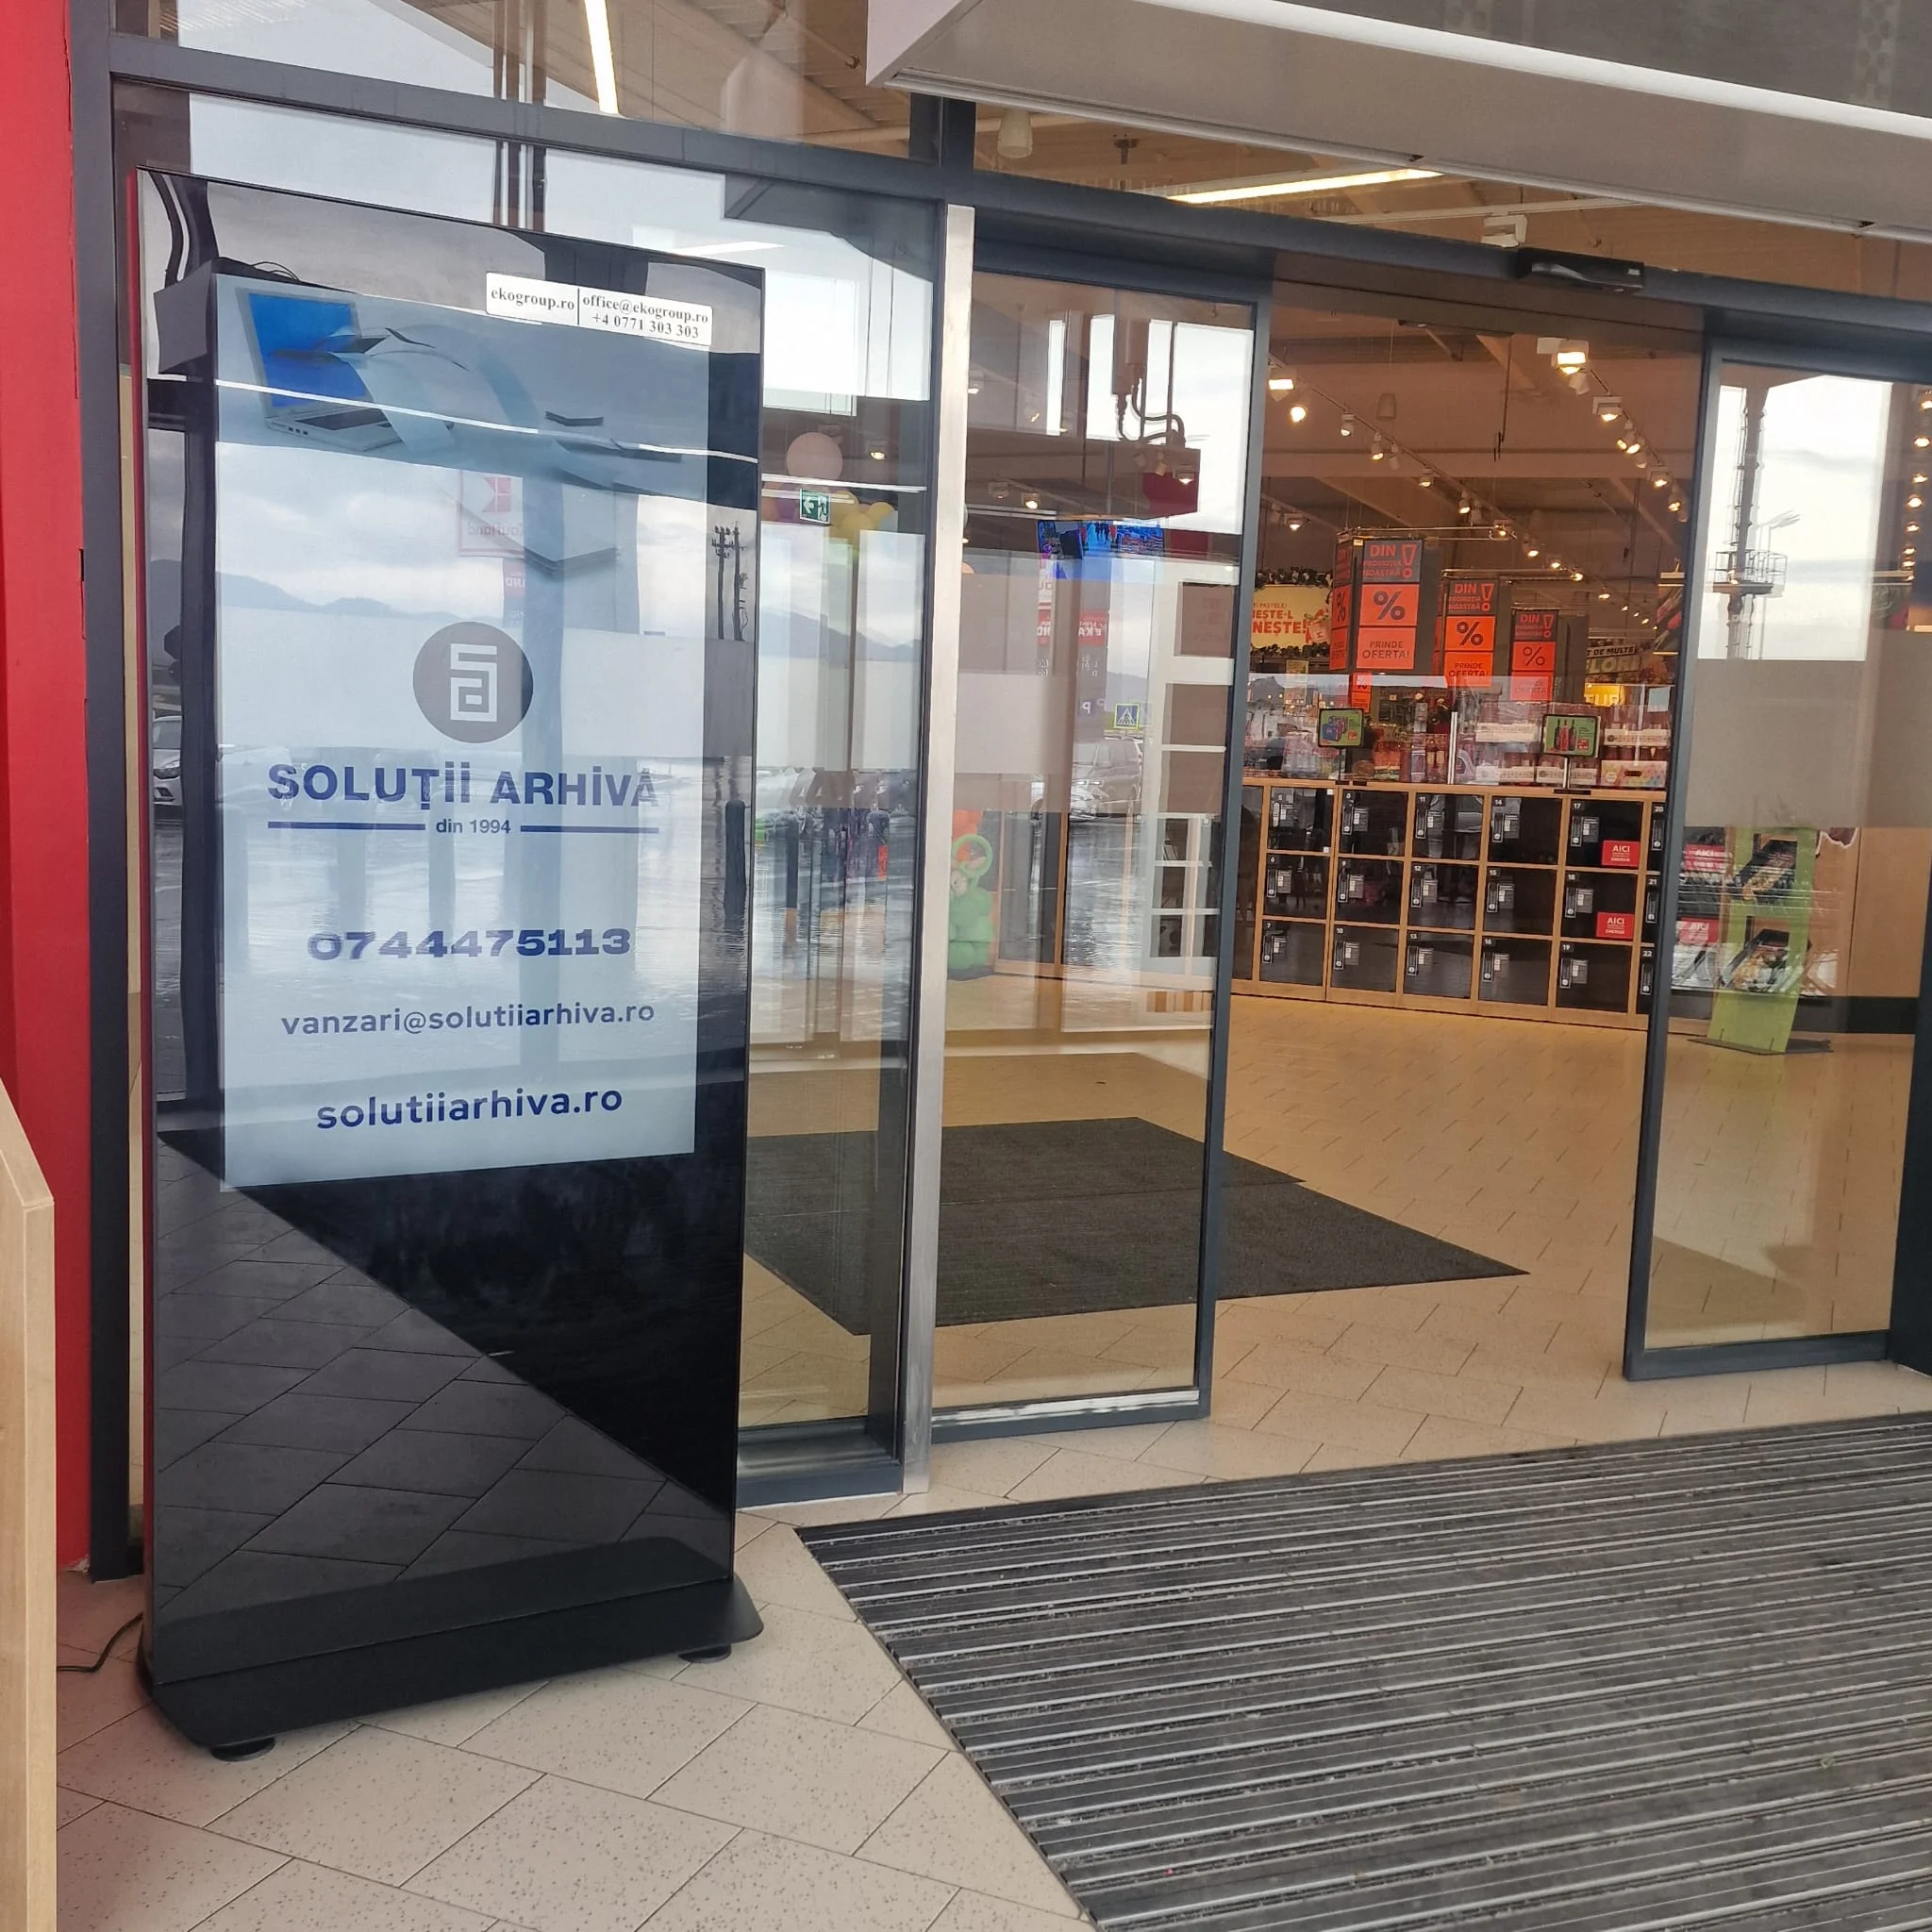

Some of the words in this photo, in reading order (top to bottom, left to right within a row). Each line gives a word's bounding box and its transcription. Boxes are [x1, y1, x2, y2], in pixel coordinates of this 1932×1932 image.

[491, 287, 575, 310] ekogroup.ro
[582, 294, 708, 324] office@ekogroup.ro
[592, 314, 609, 325] +4
[613, 314, 644, 331] 0771
[648, 320, 673, 335] 303
[675, 325, 699, 340] 303
[1370, 544, 1395, 557] DIN
[1455, 584, 1477, 594] DIN
[1373, 591, 1406, 620] %
[1520, 614, 1540, 623] DIN
[1456, 621, 1484, 646] %
[1362, 649, 1410, 659] OFERTA!
[1369, 641, 1404, 649] PRINDE
[1523, 646, 1546, 666] %
[435, 819, 463, 834] din
[470, 819, 511, 834] 1994
[1612, 844, 1630, 853] AICI
[308, 927, 631, 960] 0744475113
[281, 1002, 656, 1035] vanzari@solutiiarhiva.ro
[316, 1088, 623, 1129] solutiiarhiva.ro
